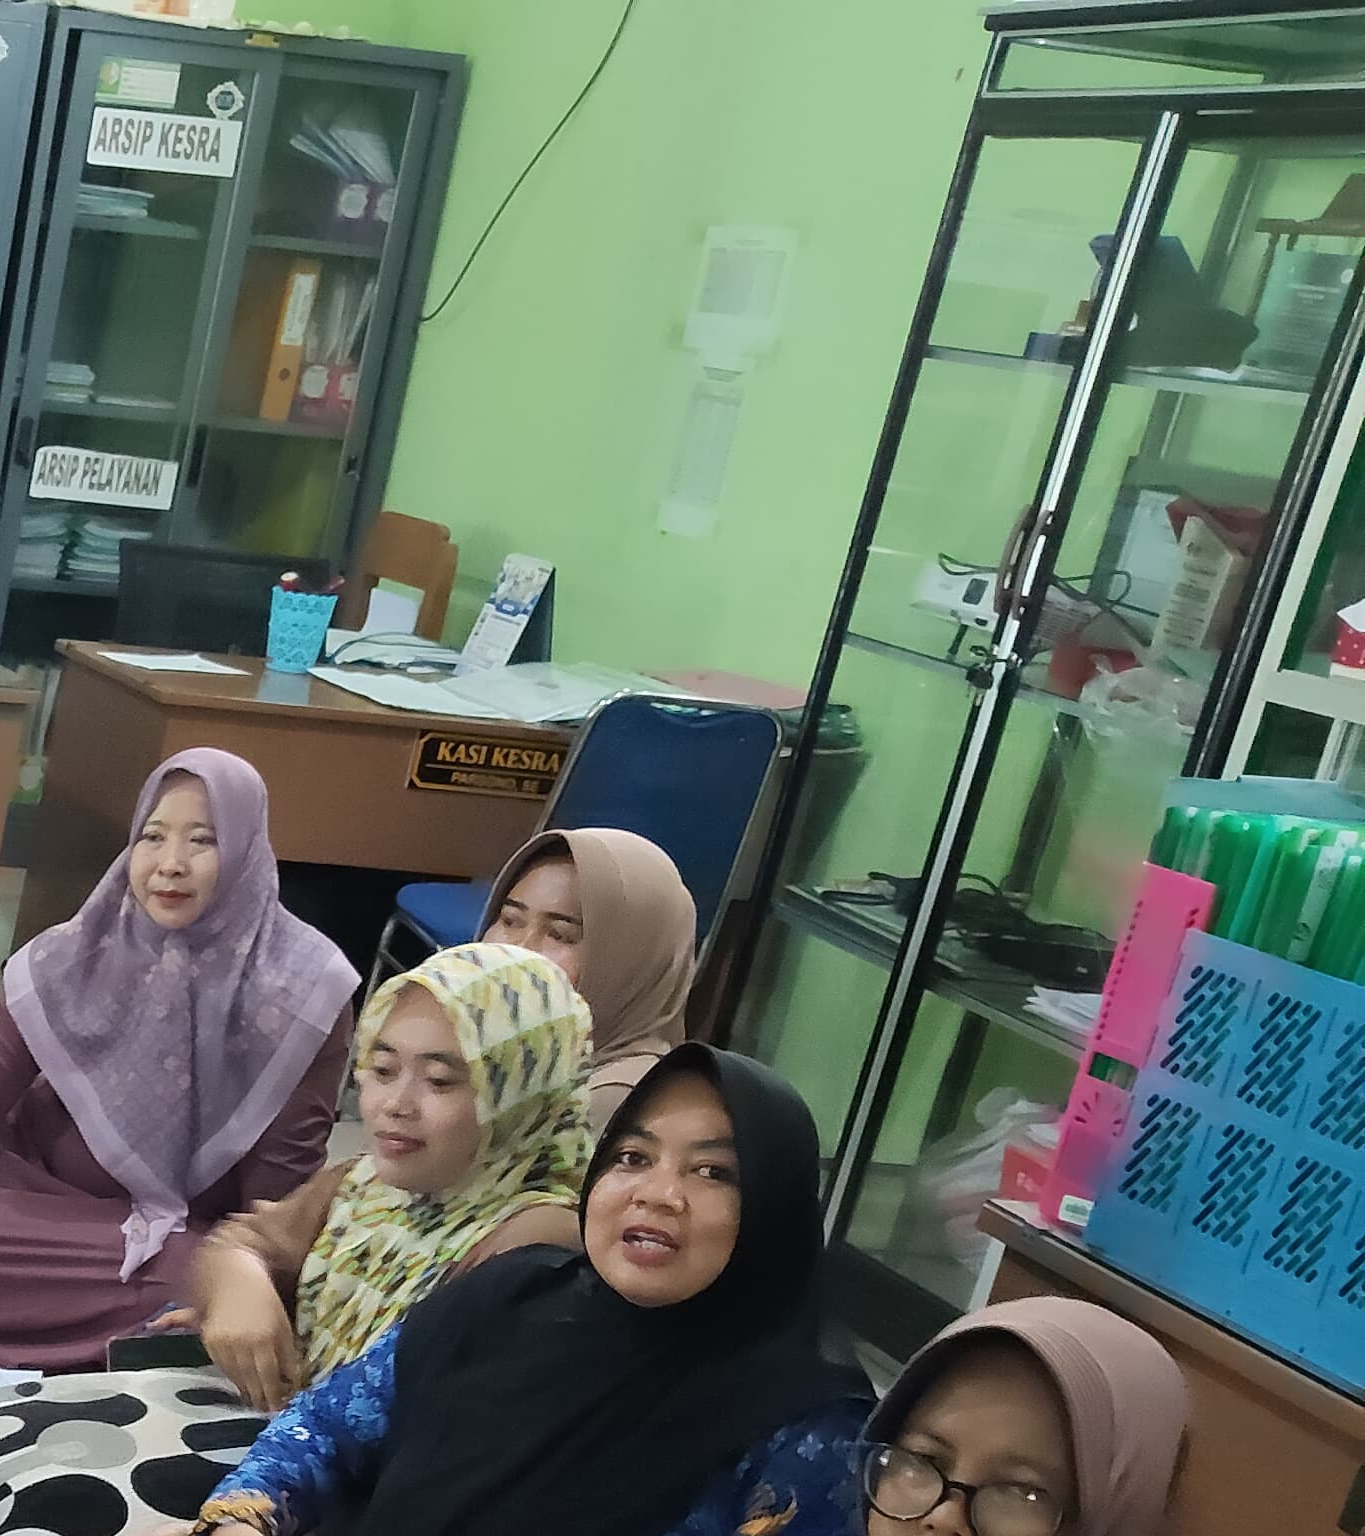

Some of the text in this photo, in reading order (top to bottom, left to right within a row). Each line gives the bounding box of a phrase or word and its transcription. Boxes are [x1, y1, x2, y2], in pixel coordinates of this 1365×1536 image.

[94, 116, 222, 164] ARSIP KESRA
[36, 451, 163, 497] ARSIP PELAYANAN
[436, 740, 560, 774] KASI KESRA
